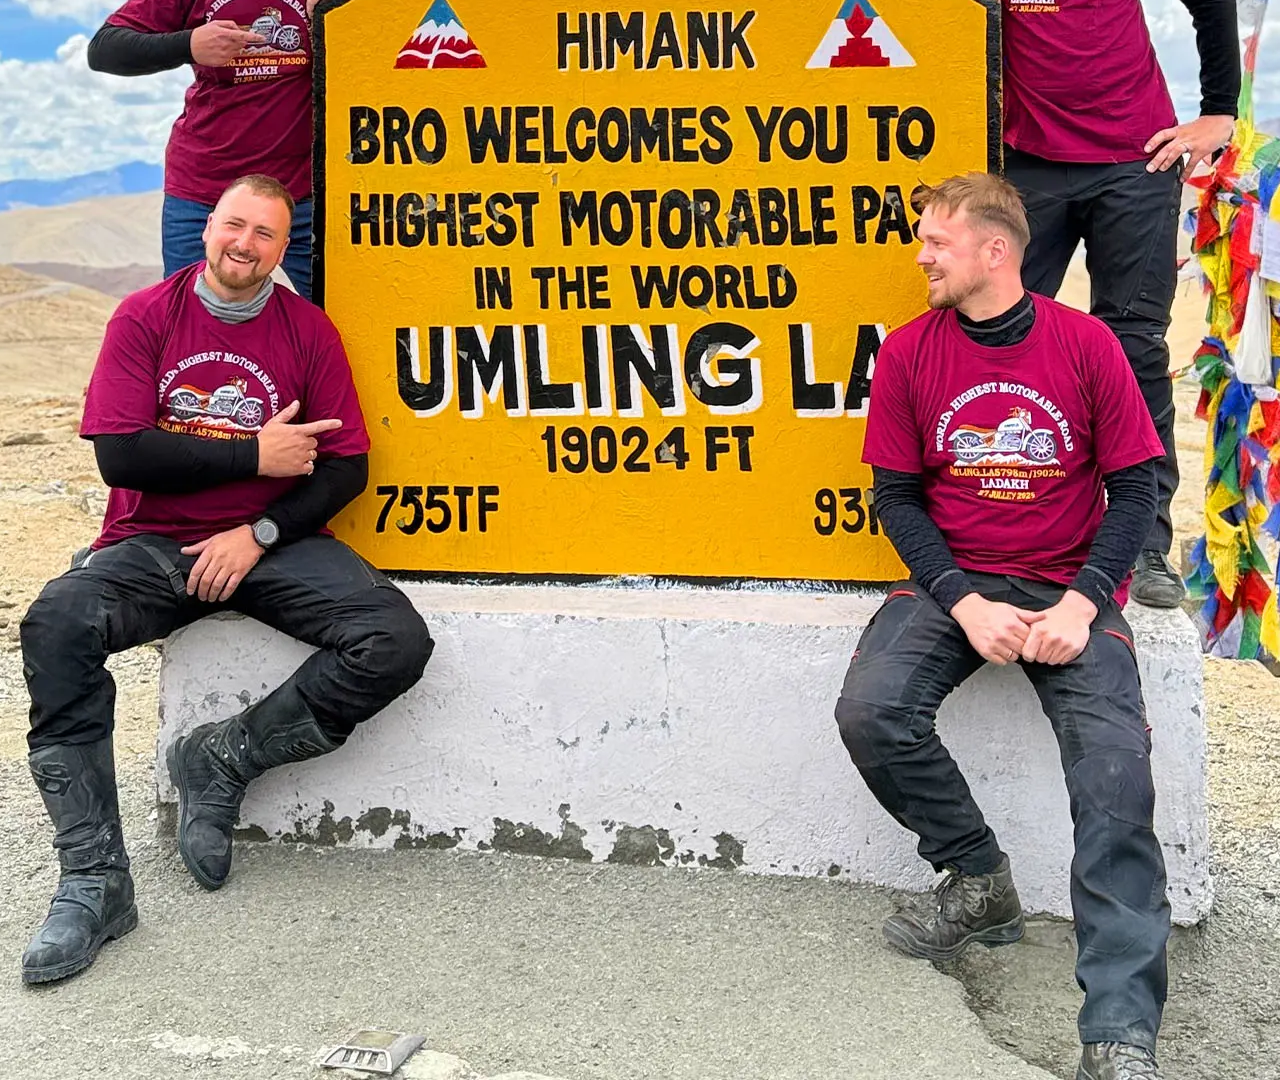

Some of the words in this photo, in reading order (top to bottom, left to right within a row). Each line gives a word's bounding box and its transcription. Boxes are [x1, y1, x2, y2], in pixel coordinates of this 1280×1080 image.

[235, 66, 278, 76] LADAKH
[556, 11, 756, 71] HIMANK
[349, 105, 447, 165] BRO
[464, 105, 732, 164] WELCOMES
[745, 105, 848, 164] YOU
[868, 105, 936, 163] TO
[350, 190, 540, 248] HIGHEST
[560, 186, 838, 249] MOTORABLE
[474, 266, 512, 310] IN
[531, 266, 611, 310] THE
[631, 264, 798, 310] WORLD
[177, 351, 222, 371] HIGHEST
[223, 352, 275, 393] MOTORABLE
[270, 391, 281, 417] ROA
[395, 323, 763, 418] UMLING
[788, 323, 888, 418] LA
[950, 382, 997, 411] HIGHEST
[999, 382, 1062, 422] MOTORABLE
[1058, 420, 1074, 452] ROAD
[540, 425, 690, 475] 19024
[705, 425, 755, 474] FT
[375, 485, 500, 536] 755TF
[980, 478, 1030, 489] LADAKH
